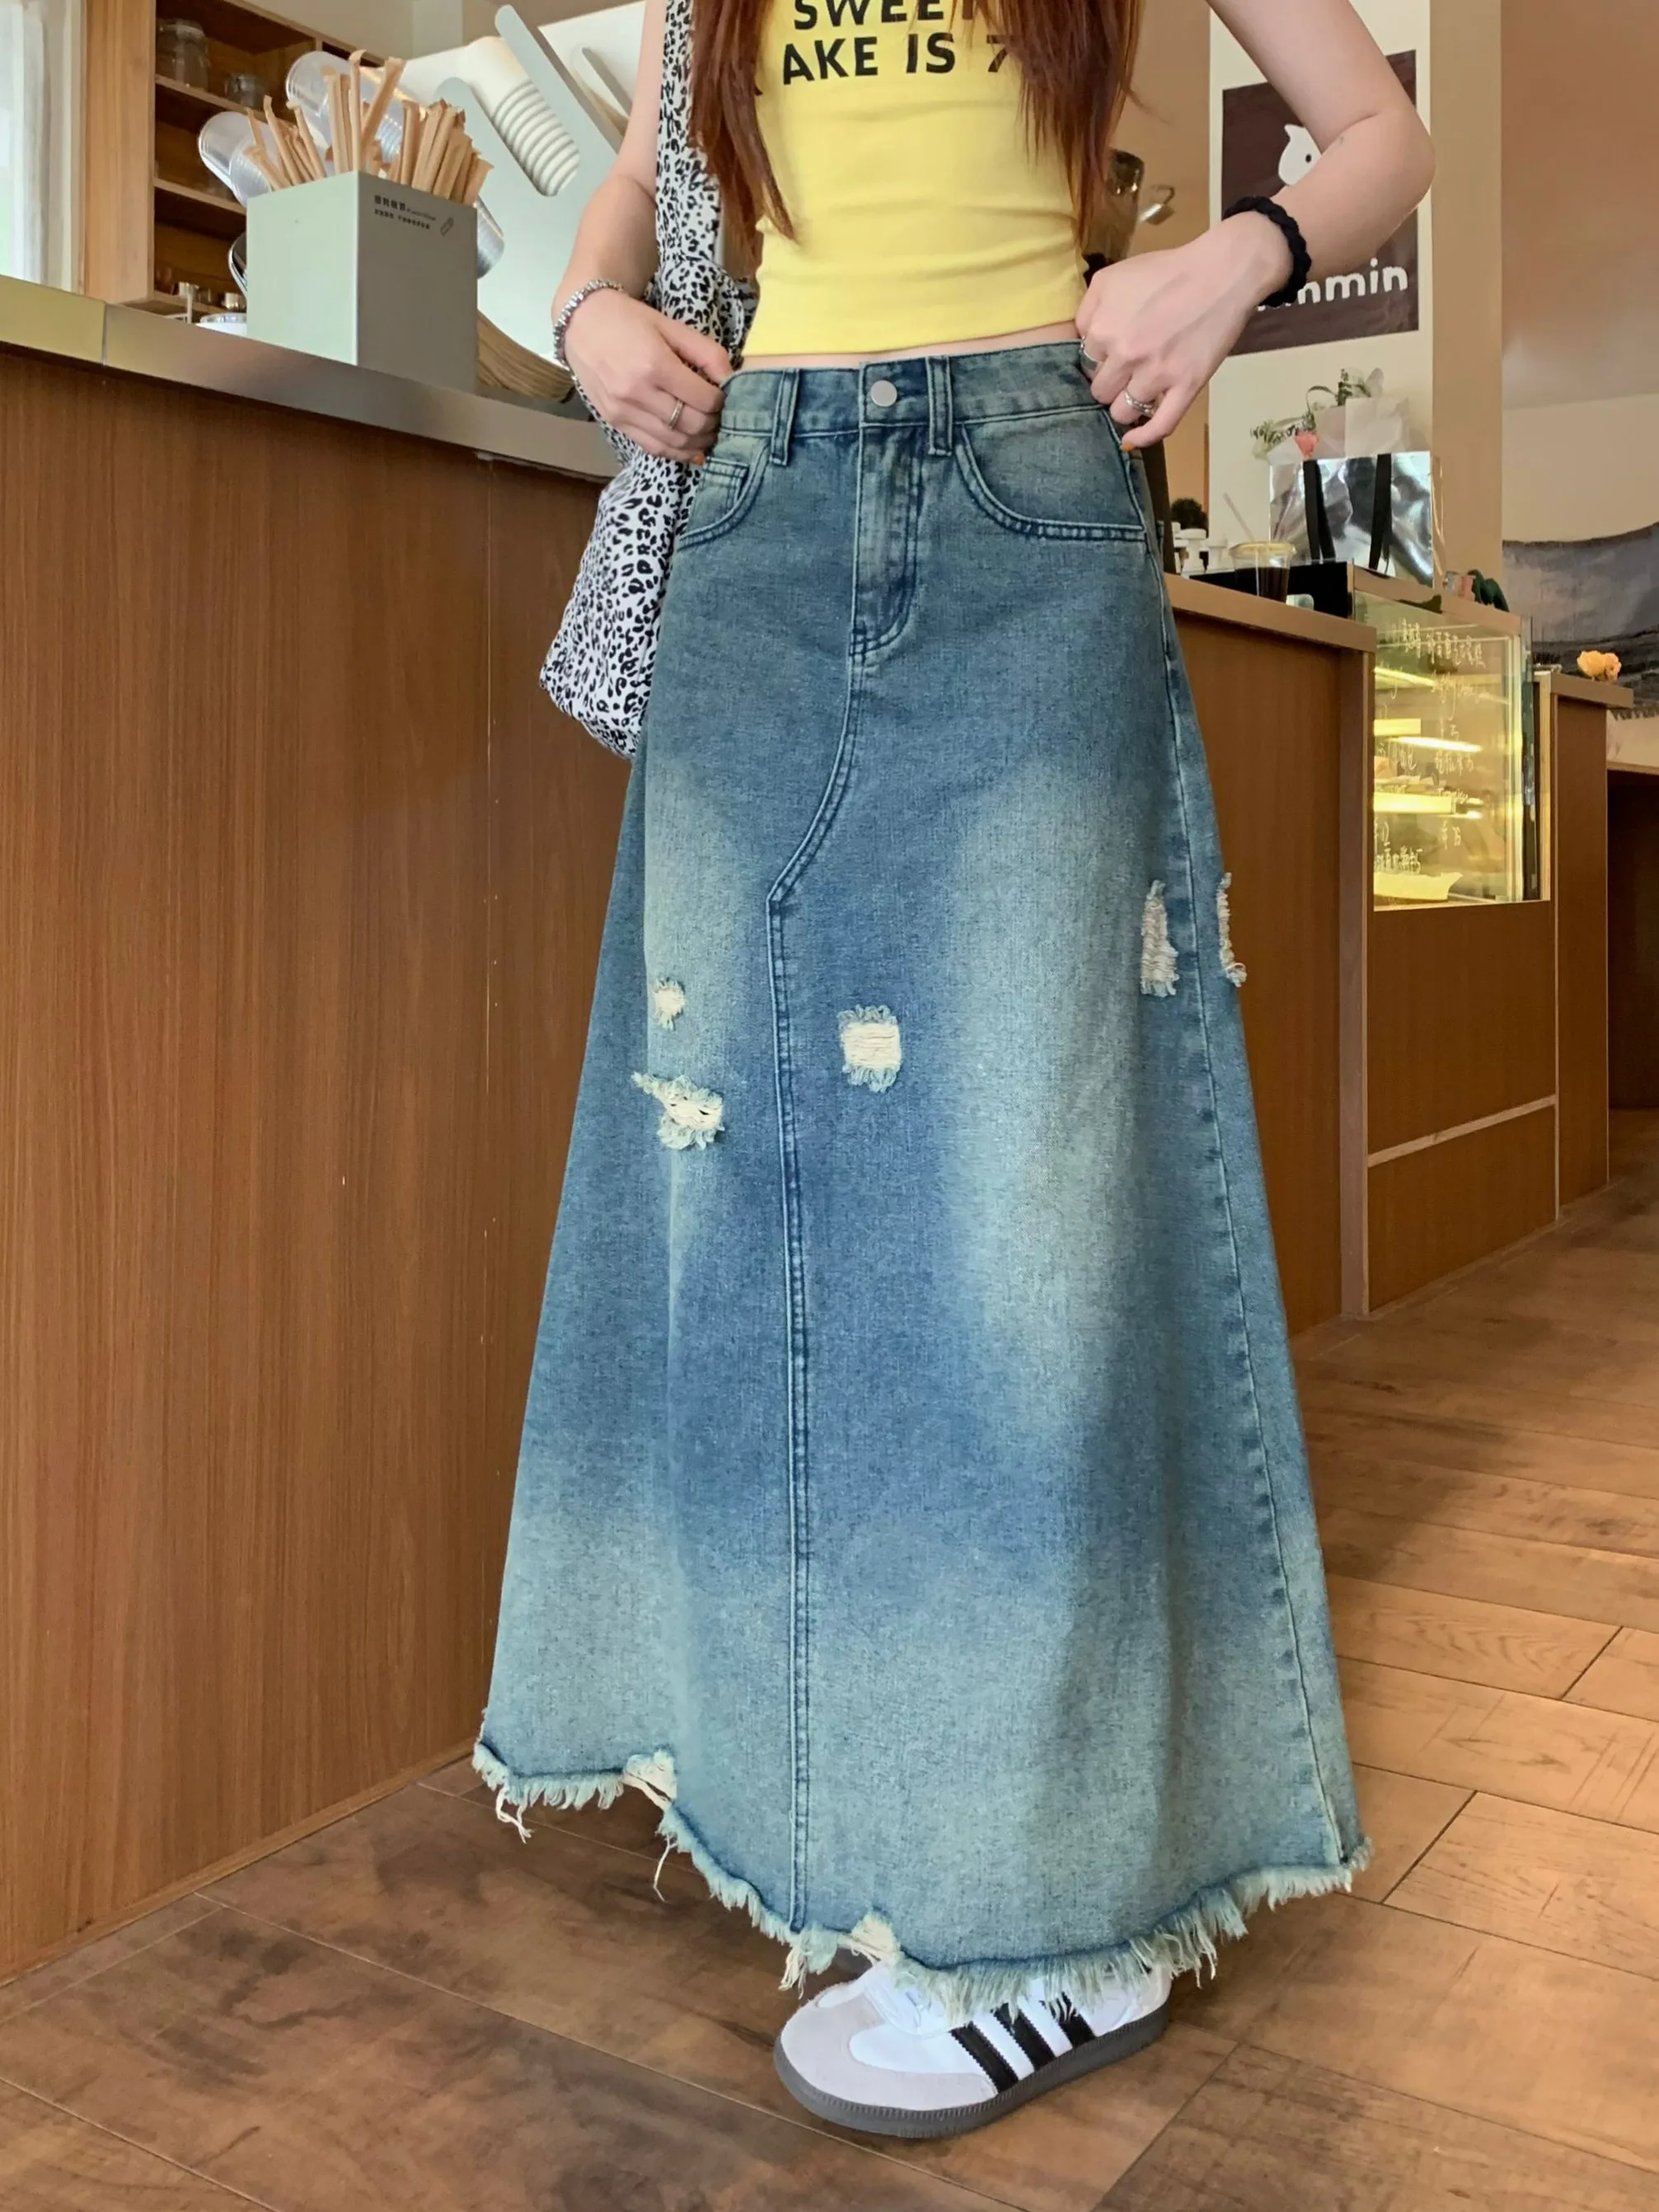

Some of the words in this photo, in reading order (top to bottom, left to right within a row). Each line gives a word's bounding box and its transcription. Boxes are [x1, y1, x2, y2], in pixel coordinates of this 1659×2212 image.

[755, 36, 878, 96] AKE
[905, 33, 955, 73] IS
[1258, 257, 1408, 312] nmin
